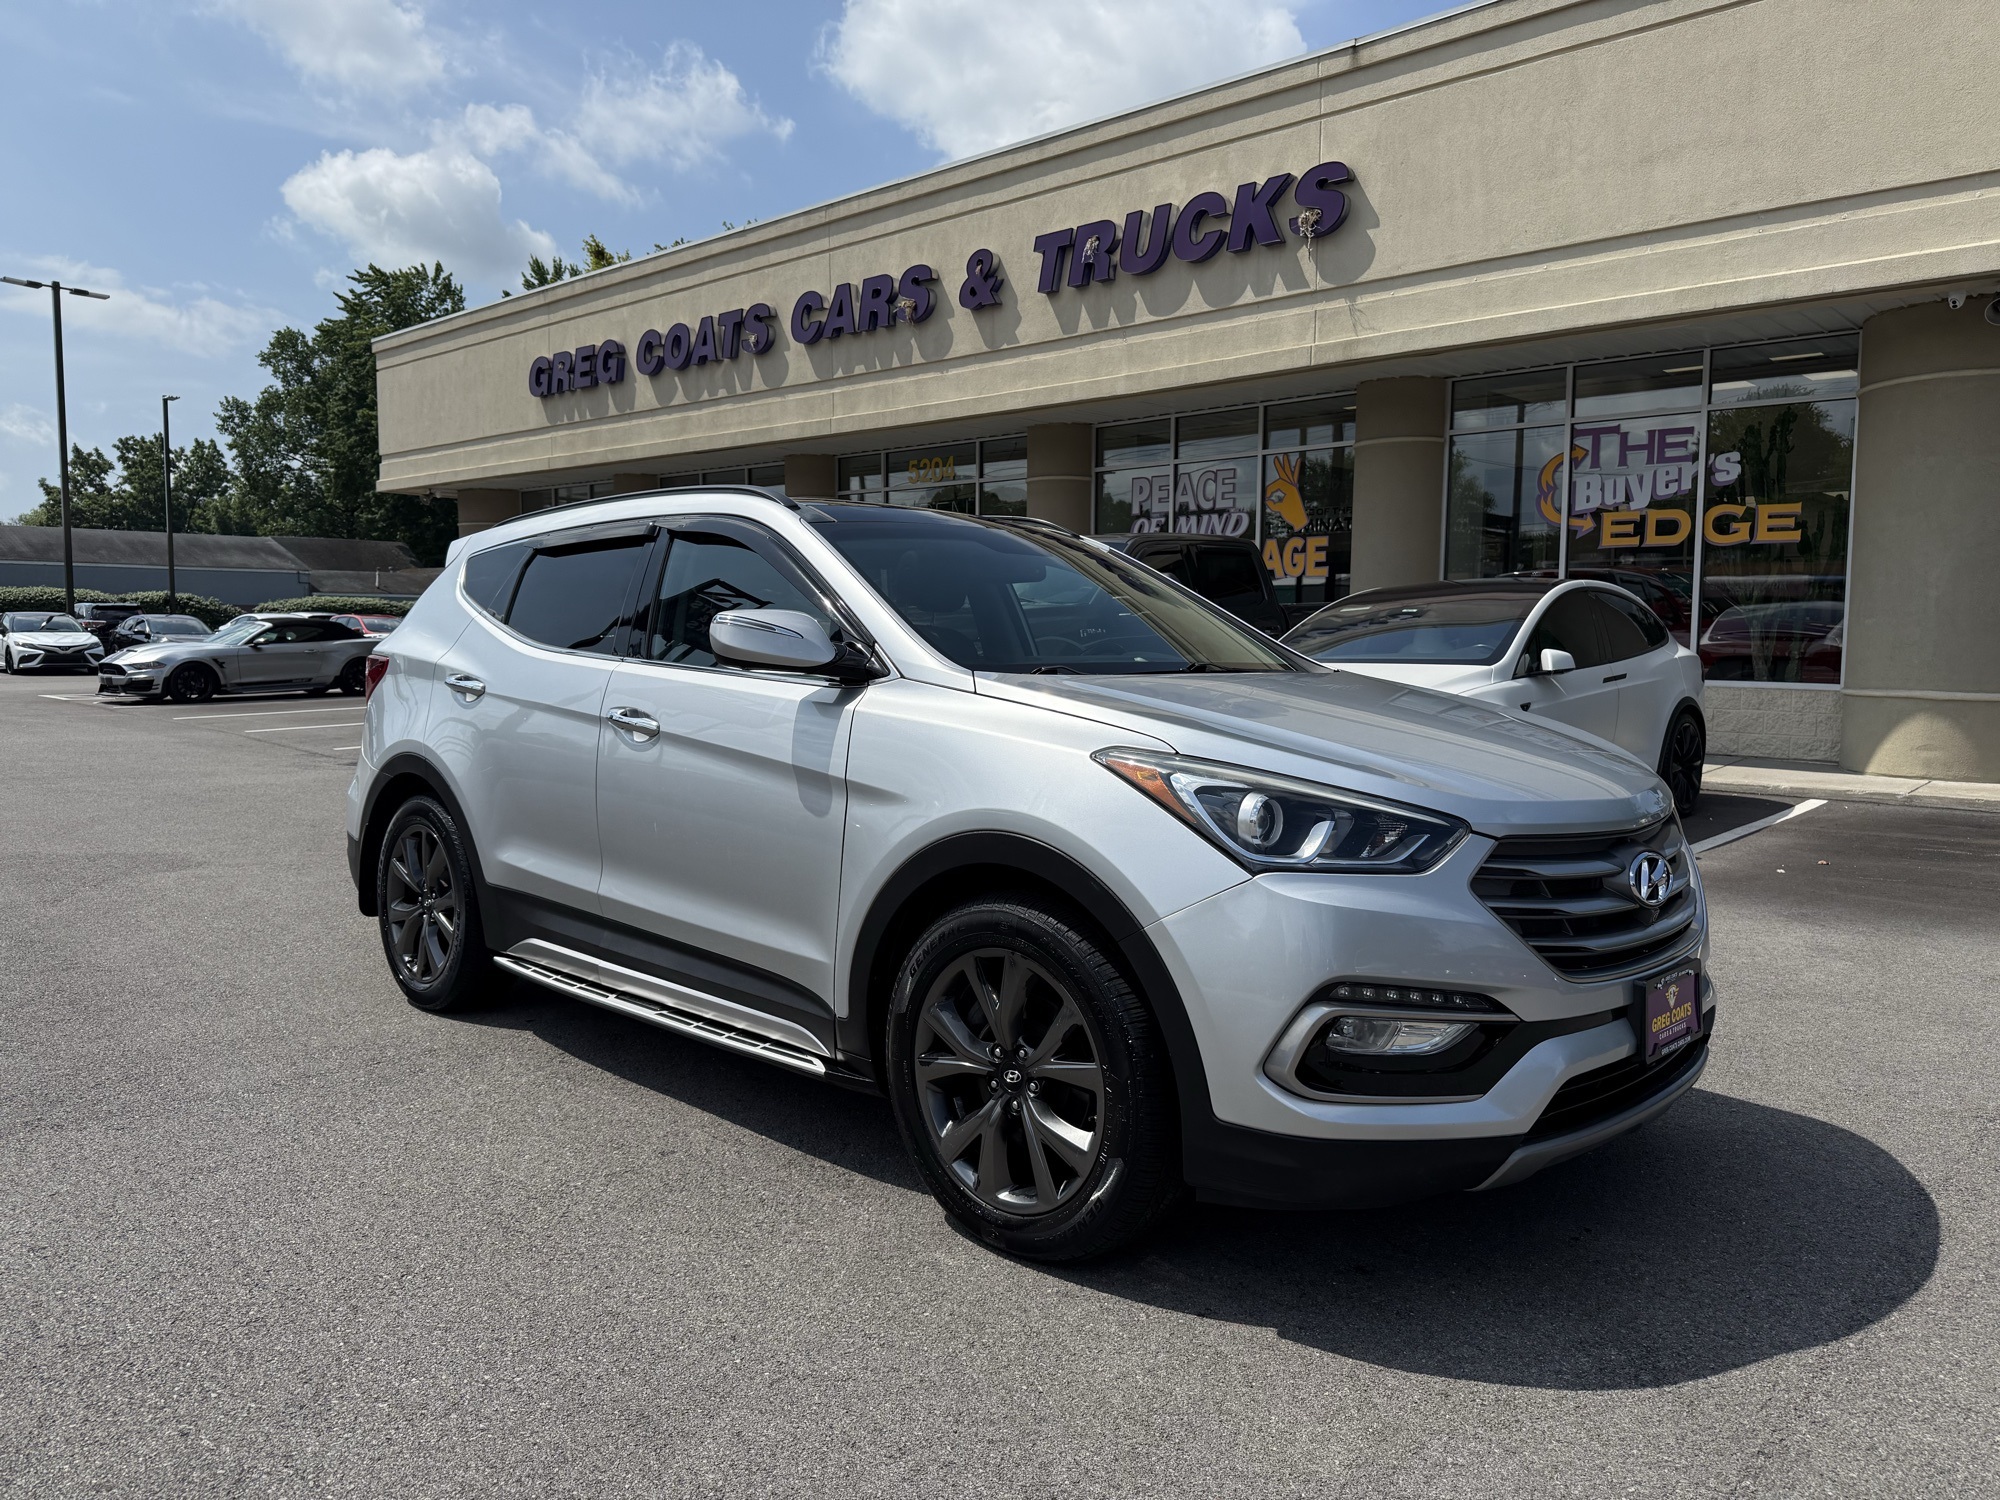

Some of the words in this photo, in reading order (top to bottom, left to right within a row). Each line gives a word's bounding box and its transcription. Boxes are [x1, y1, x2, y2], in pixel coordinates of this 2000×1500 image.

[529, 339, 626, 398] GREG
[636, 302, 777, 376] COATS
[791, 263, 940, 345] CARS
[958, 248, 1004, 311] &
[1033, 160, 1356, 294] TRUCKS
[907, 455, 957, 484] 5204
[1572, 424, 1696, 470] THE
[1131, 468, 1237, 516] PEACE
[1572, 450, 1742, 514] Buyer's
[1131, 516, 1166, 534] OF
[1175, 511, 1251, 538] MIND
[1599, 501, 1803, 549] EDGE
[1262, 535, 1330, 579] AGE
[1652, 1012, 1671, 1033] GREG
[1672, 1002, 1692, 1022] COATS
